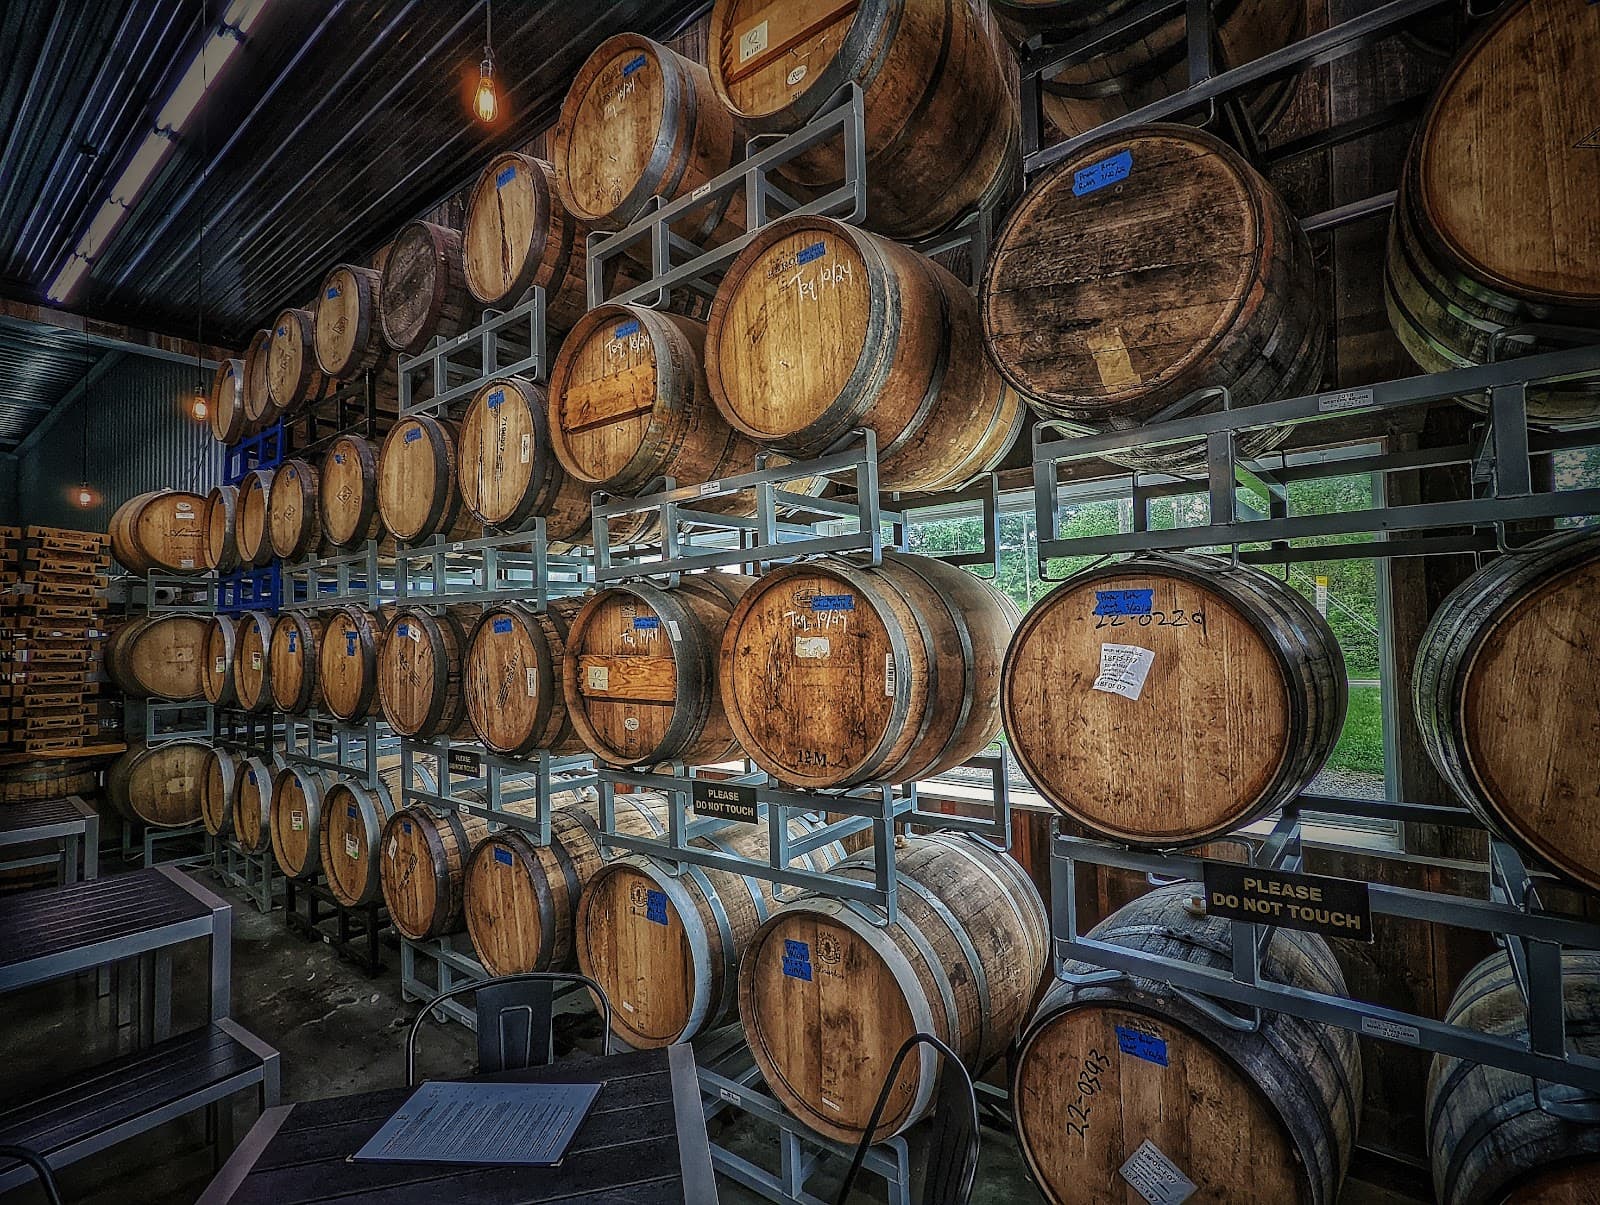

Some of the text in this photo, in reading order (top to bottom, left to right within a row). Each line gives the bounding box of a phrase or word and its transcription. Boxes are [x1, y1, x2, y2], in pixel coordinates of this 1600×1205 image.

[786, 268, 818, 301] Teq
[820, 259, 853, 290] 10/24
[696, 800, 754, 817] DO NOT TOUCH
[708, 789, 740, 801] PLEASE
[1243, 877, 1323, 902] PLEASE
[1212, 892, 1361, 930] DO NOT TOUCH
[1067, 1049, 1110, 1139] 22-0393
